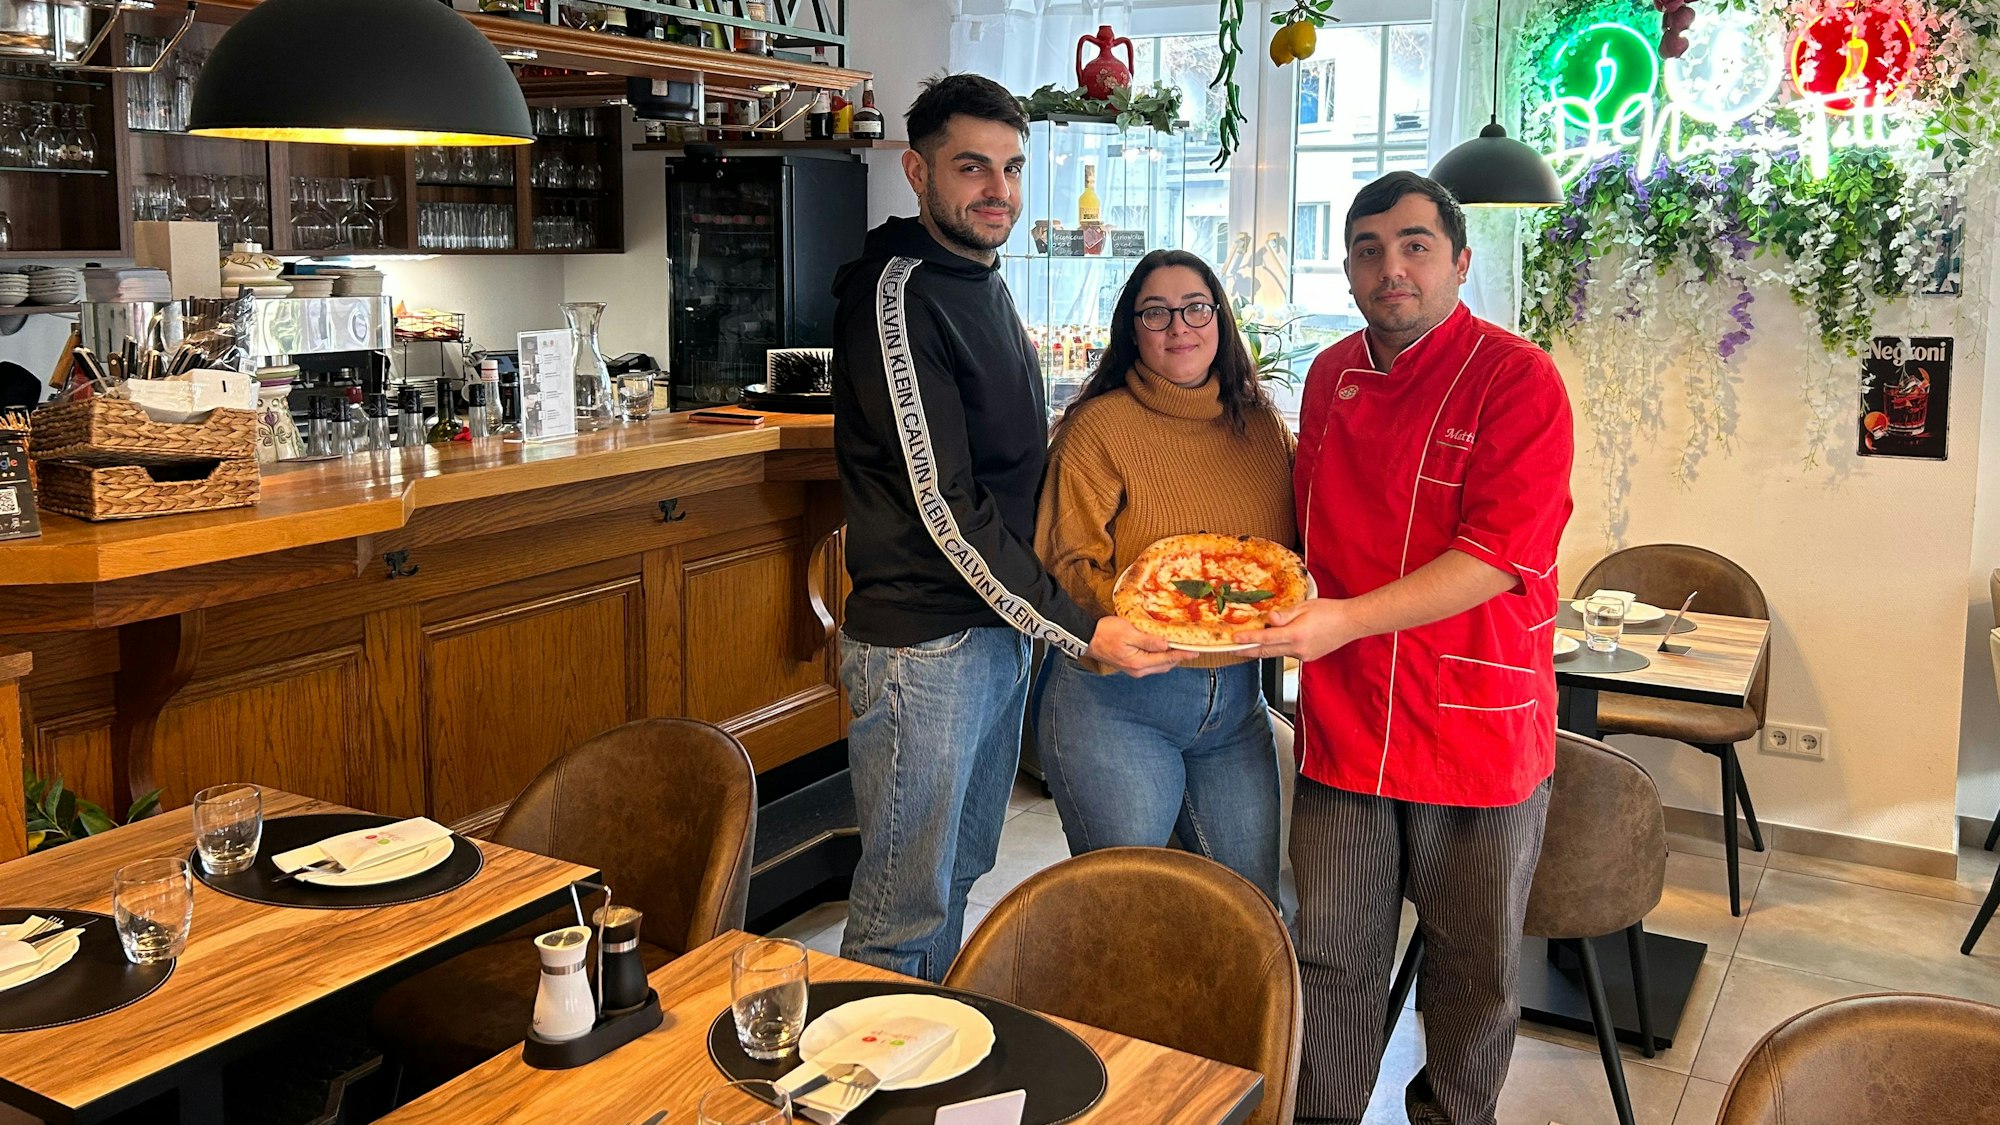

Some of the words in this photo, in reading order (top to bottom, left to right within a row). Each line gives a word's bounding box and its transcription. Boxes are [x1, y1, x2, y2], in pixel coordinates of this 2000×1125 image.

[882, 281, 902, 350] CALVIN
[889, 354, 915, 409] KLEIN
[902, 412, 932, 484] CALVIN
[919, 486, 952, 538] KLEIN
[944, 538, 997, 597] CALVIN
[994, 594, 1041, 634] KLEIN
